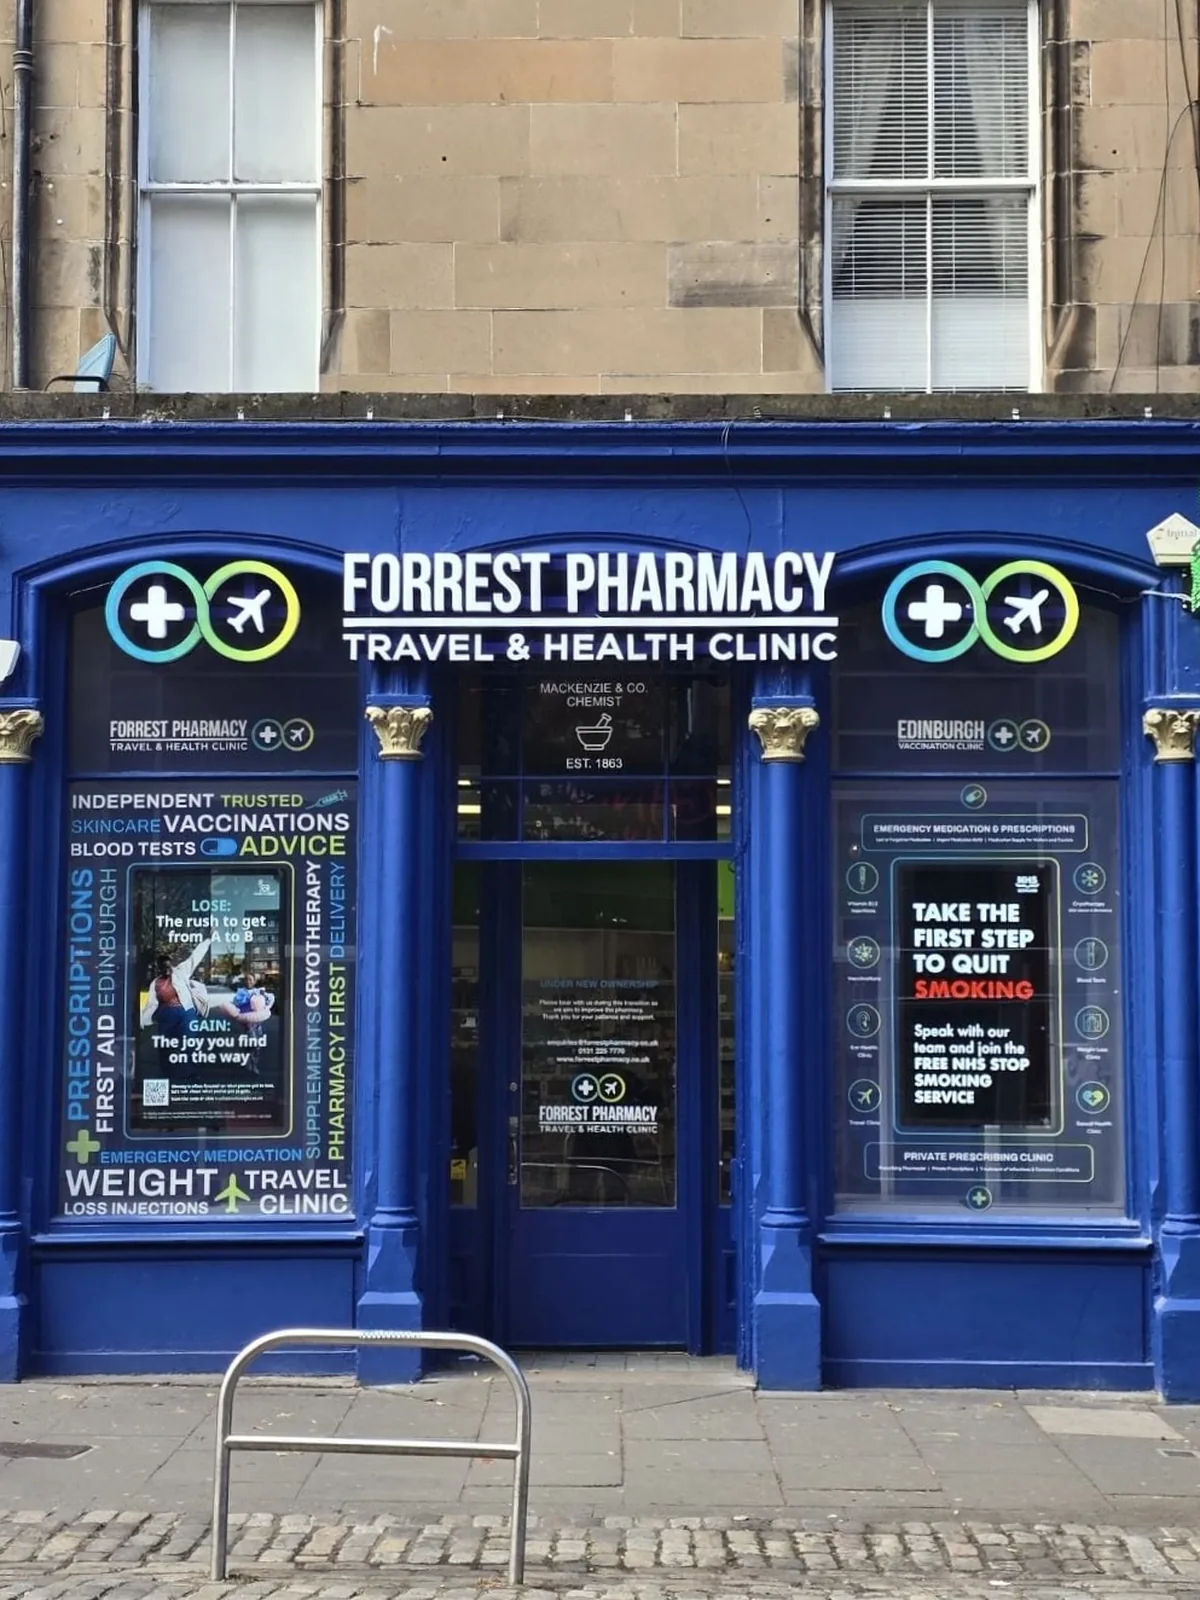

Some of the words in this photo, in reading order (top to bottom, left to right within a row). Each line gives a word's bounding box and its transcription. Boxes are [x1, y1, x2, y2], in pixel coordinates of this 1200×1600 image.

[343, 552, 550, 612] FORREST
[566, 552, 836, 612] PHARMACY
[343, 633, 494, 661] TRAVEL
[507, 633, 531, 661] &
[544, 633, 694, 661] HEALTH
[708, 632, 838, 661] CLINIC
[540, 683, 612, 694] MACKENZIE
[615, 683, 623, 693] &
[626, 682, 648, 693] CO.
[566, 696, 622, 707] CHEMIST
[110, 720, 169, 738] FORREST
[172, 719, 248, 737] PHARMACY
[898, 719, 985, 739] EDINBURGH
[110, 743, 152, 752] TRAVEL
[155, 743, 162, 751] &
[166, 742, 209, 751] HEALTH
[211, 742, 248, 751] CLINIC
[898, 742, 955, 750] VACCINATION
[566, 758, 591, 769] EST.
[596, 758, 623, 769] 1863
[72, 794, 214, 809] INDEPENDENT
[220, 794, 303, 808] TRUSTED
[71, 818, 161, 833] SKINCARE
[163, 813, 350, 833] VACCINATIONS
[873, 824, 931, 833] EMERGENCY
[933, 825, 990, 833] MEDICATION
[1001, 825, 1075, 833] PRESCRIPTIONS
[70, 843, 133, 857] BLOOD
[138, 841, 196, 856] TESTS
[239, 835, 346, 856] ADVICE
[1016, 876, 1038, 884] NHS
[191, 899, 231, 912] LOSE:
[330, 861, 345, 958] DELIVERY
[912, 903, 971, 922] TAKE
[976, 903, 1020, 922] THE
[156, 915, 183, 927] The
[187, 914, 218, 927] rush
[223, 916, 238, 927] to
[242, 916, 266, 930] get
[98, 868, 117, 1007] EDINBURGH
[168, 930, 203, 943] from
[211, 931, 221, 942] A
[225, 931, 239, 942] to
[244, 930, 253, 942] B
[305, 860, 322, 1007] CRYOTHERAPY
[914, 928, 975, 947] FIRST
[981, 929, 1034, 948] STEP
[912, 954, 945, 973] TO
[952, 954, 1010, 974] QUIT
[540, 980, 573, 988] UNDER
[576, 980, 597, 988] NEW
[600, 980, 659, 988] OWNERSHIP
[915, 980, 1034, 999] SMOKING
[68, 869, 93, 1120] PRESCRIPTIONS
[329, 962, 346, 1026] FIRST
[189, 1020, 231, 1032] GAIN:
[914, 1023, 954, 1040] Speak
[957, 1023, 984, 1037] with
[987, 1028, 1010, 1037] our
[97, 1014, 115, 1056] AID
[151, 1035, 179, 1048] The
[181, 1035, 204, 1051] joy
[207, 1037, 234, 1051] you
[238, 1034, 267, 1047] find
[914, 1042, 946, 1054] team
[949, 1040, 974, 1054] and
[977, 1041, 1001, 1057] join
[1004, 1041, 1025, 1054] the
[169, 1053, 188, 1063] on
[192, 1051, 216, 1063] the
[219, 1052, 250, 1066] way
[914, 1057, 948, 1070] FREE
[952, 1057, 986, 1071] NHS
[990, 1058, 1030, 1071] STOP
[306, 1011, 322, 1159] SUPPLEMENTS
[914, 1073, 992, 1088] SMOKING
[95, 1062, 114, 1133] FIRST
[328, 1032, 345, 1160] PHARMACY
[914, 1090, 975, 1104] SERVICE
[539, 1106, 589, 1121] FORREST
[592, 1106, 658, 1121] PHARMACY
[539, 1125, 575, 1133] TRAVEL
[587, 1125, 624, 1133] HEALTH
[626, 1125, 658, 1134] CLINIC
[100, 1150, 199, 1164] EMERGENCY
[204, 1149, 302, 1162] MEDICATION
[904, 1152, 947, 1161] PRIVATE
[949, 1152, 1018, 1162] PRESCRIBING
[1020, 1153, 1053, 1162] CLINIC
[65, 1168, 218, 1197] WEIGHT
[244, 1169, 346, 1189] TRAVEL
[64, 1202, 108, 1215] LOSS
[111, 1202, 208, 1215] INJECTIONS
[260, 1193, 347, 1214] CLINIC
